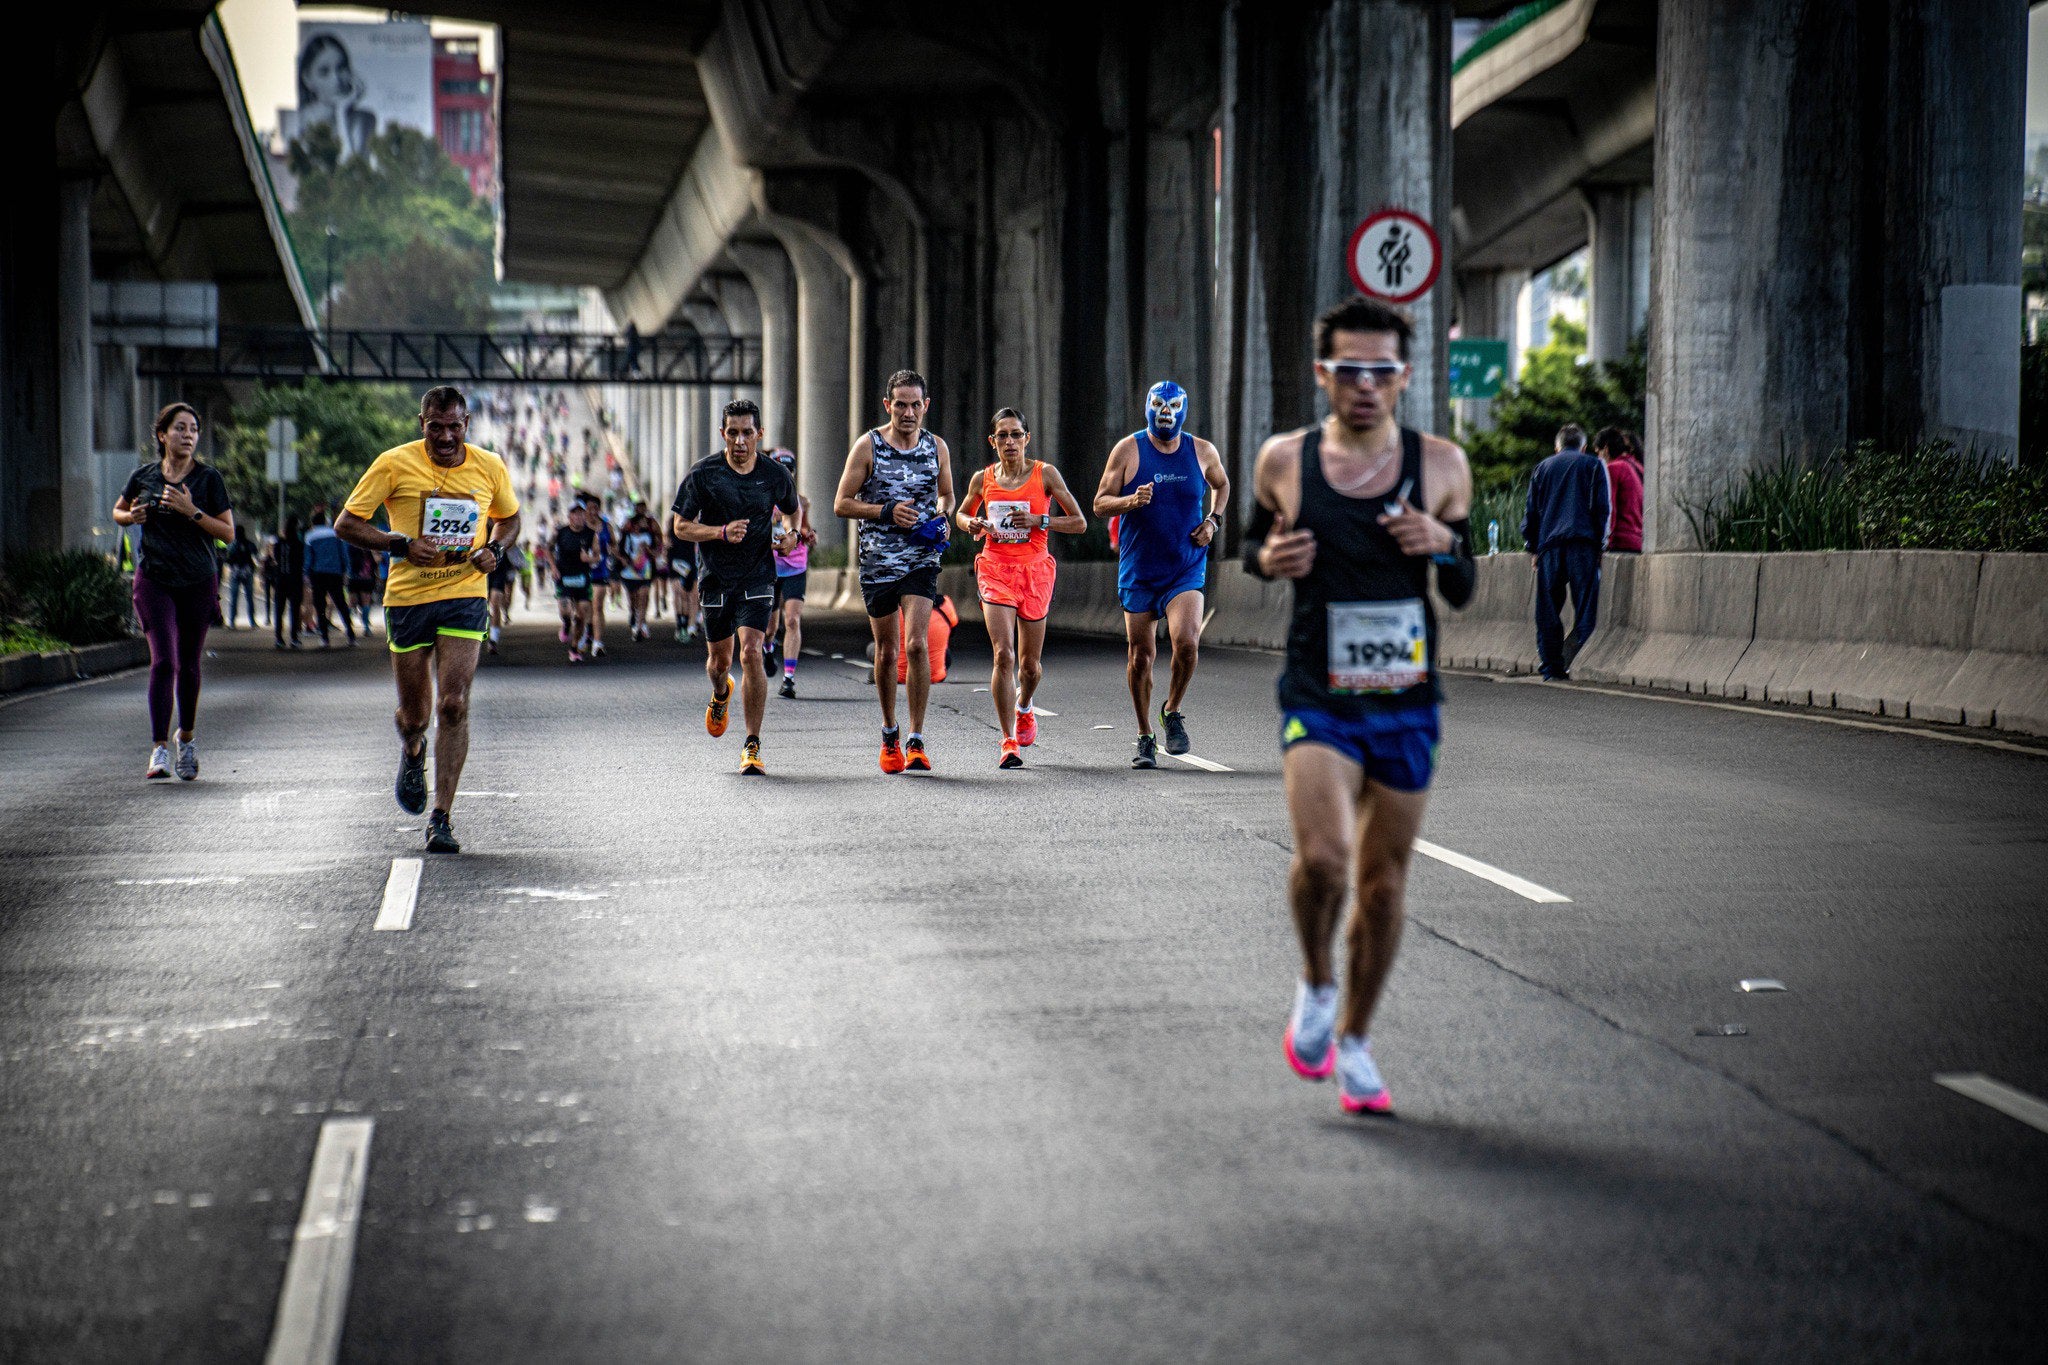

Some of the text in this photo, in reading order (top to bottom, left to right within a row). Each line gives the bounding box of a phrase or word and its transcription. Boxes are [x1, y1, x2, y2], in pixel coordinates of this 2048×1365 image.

[430, 519, 470, 534] 2936
[420, 568, 461, 579] aethlos
[1345, 642, 1412, 666] 1994
